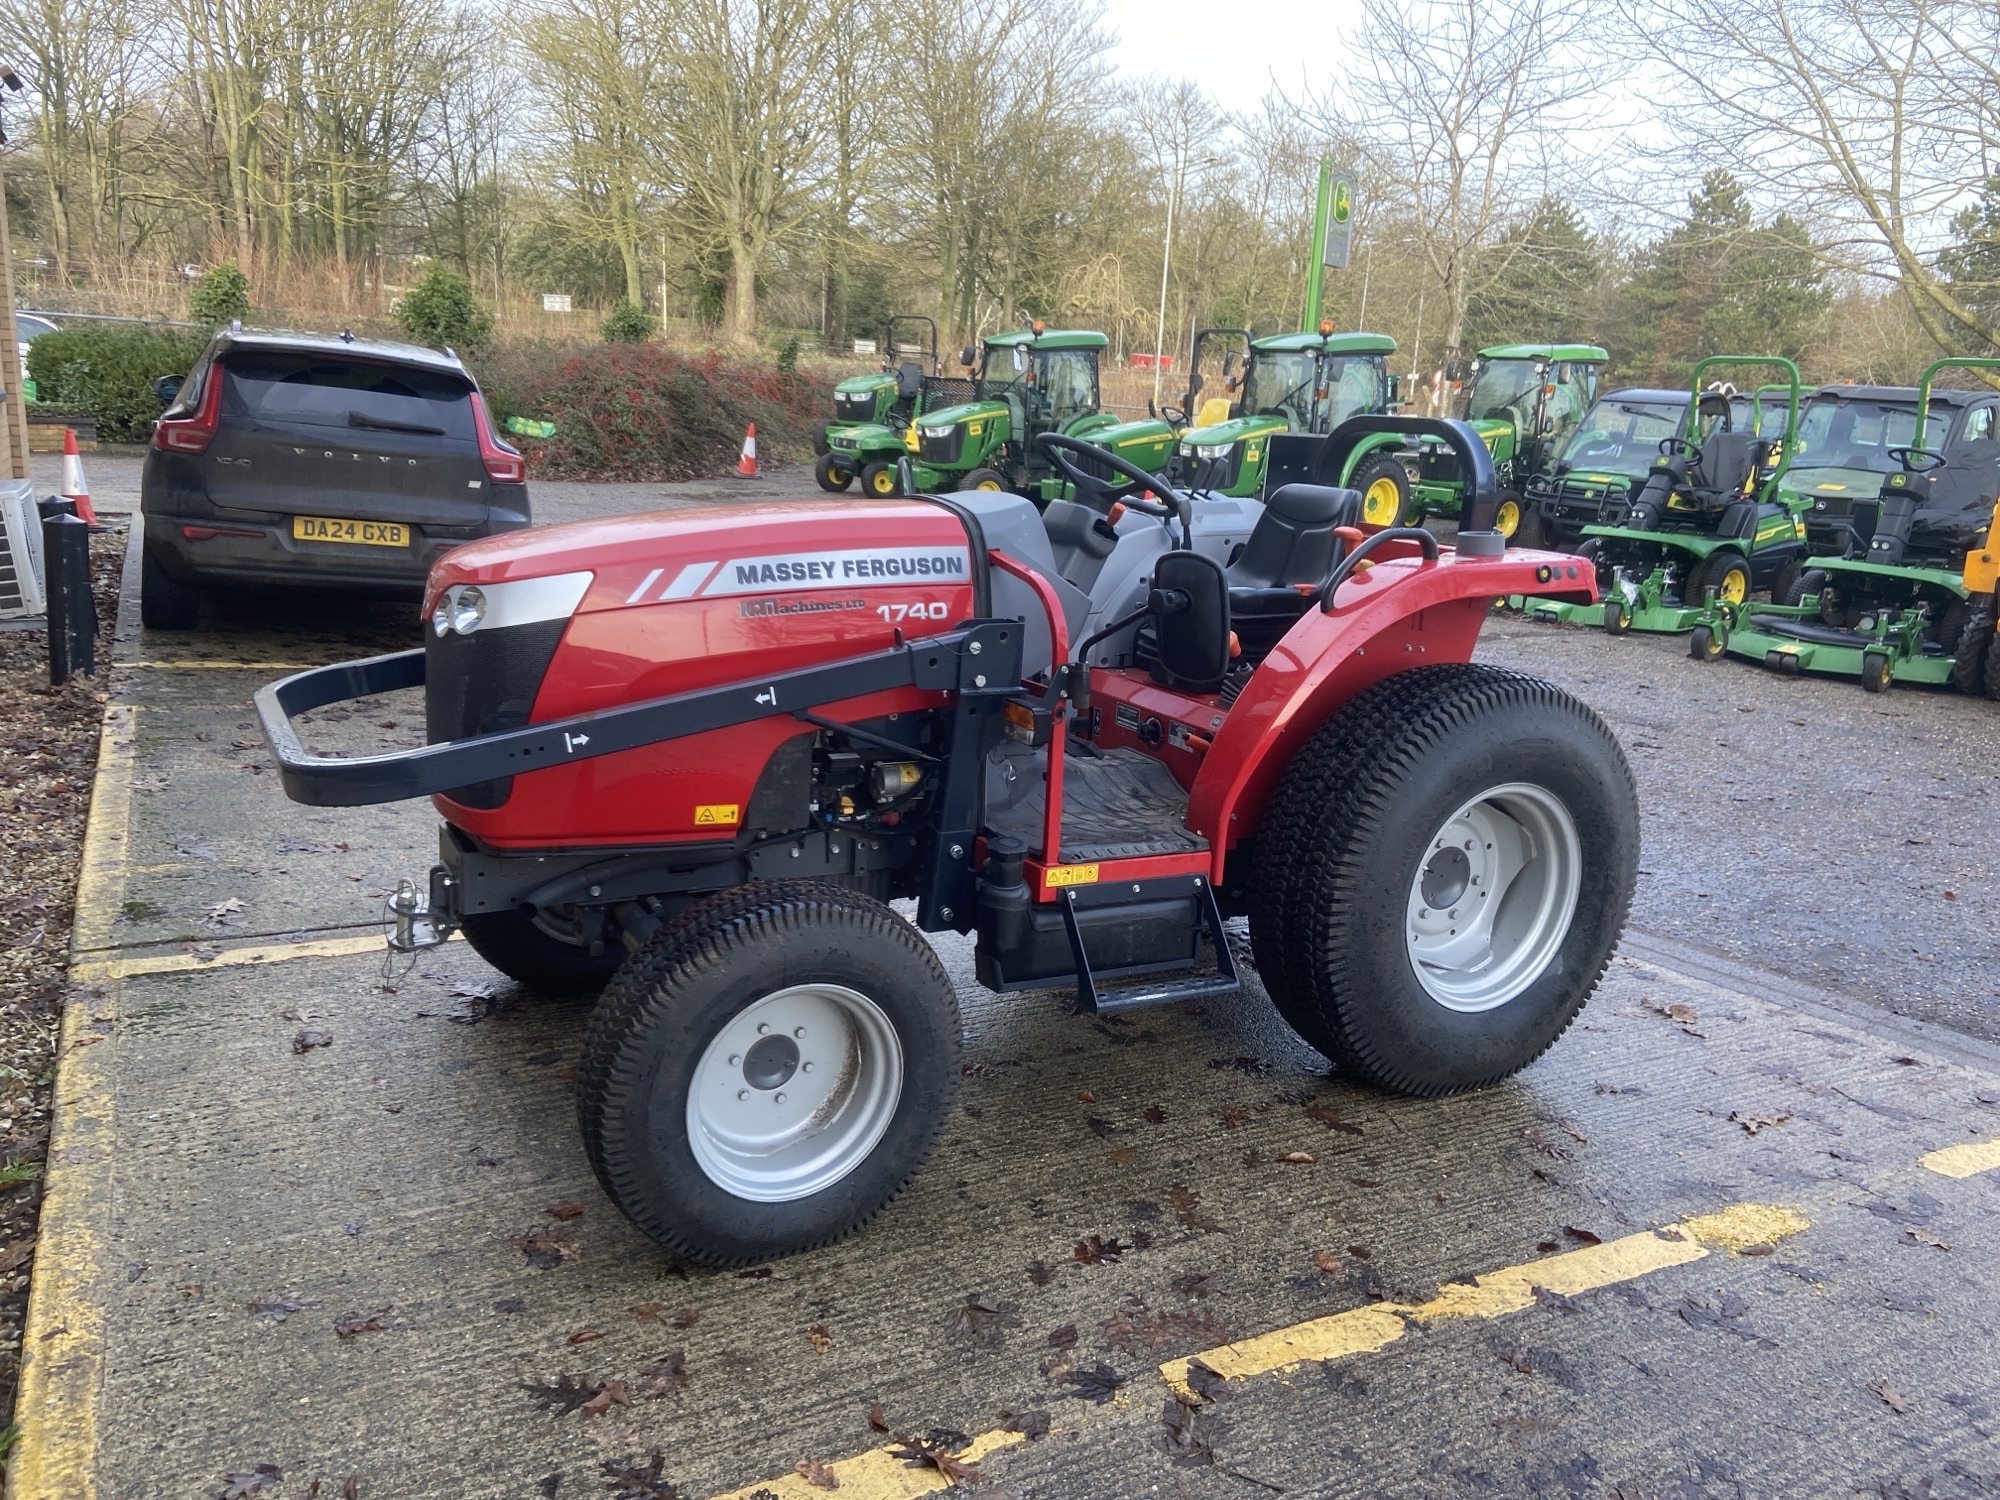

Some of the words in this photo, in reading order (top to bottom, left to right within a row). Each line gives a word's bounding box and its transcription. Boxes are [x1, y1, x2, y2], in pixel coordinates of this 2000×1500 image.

[293, 447, 417, 466] VOLVO
[303, 519, 356, 540] DA24
[362, 523, 402, 543] GXB
[735, 560, 837, 585] MASSEY
[841, 555, 964, 579] FERGUSON
[875, 601, 949, 623] 1740
